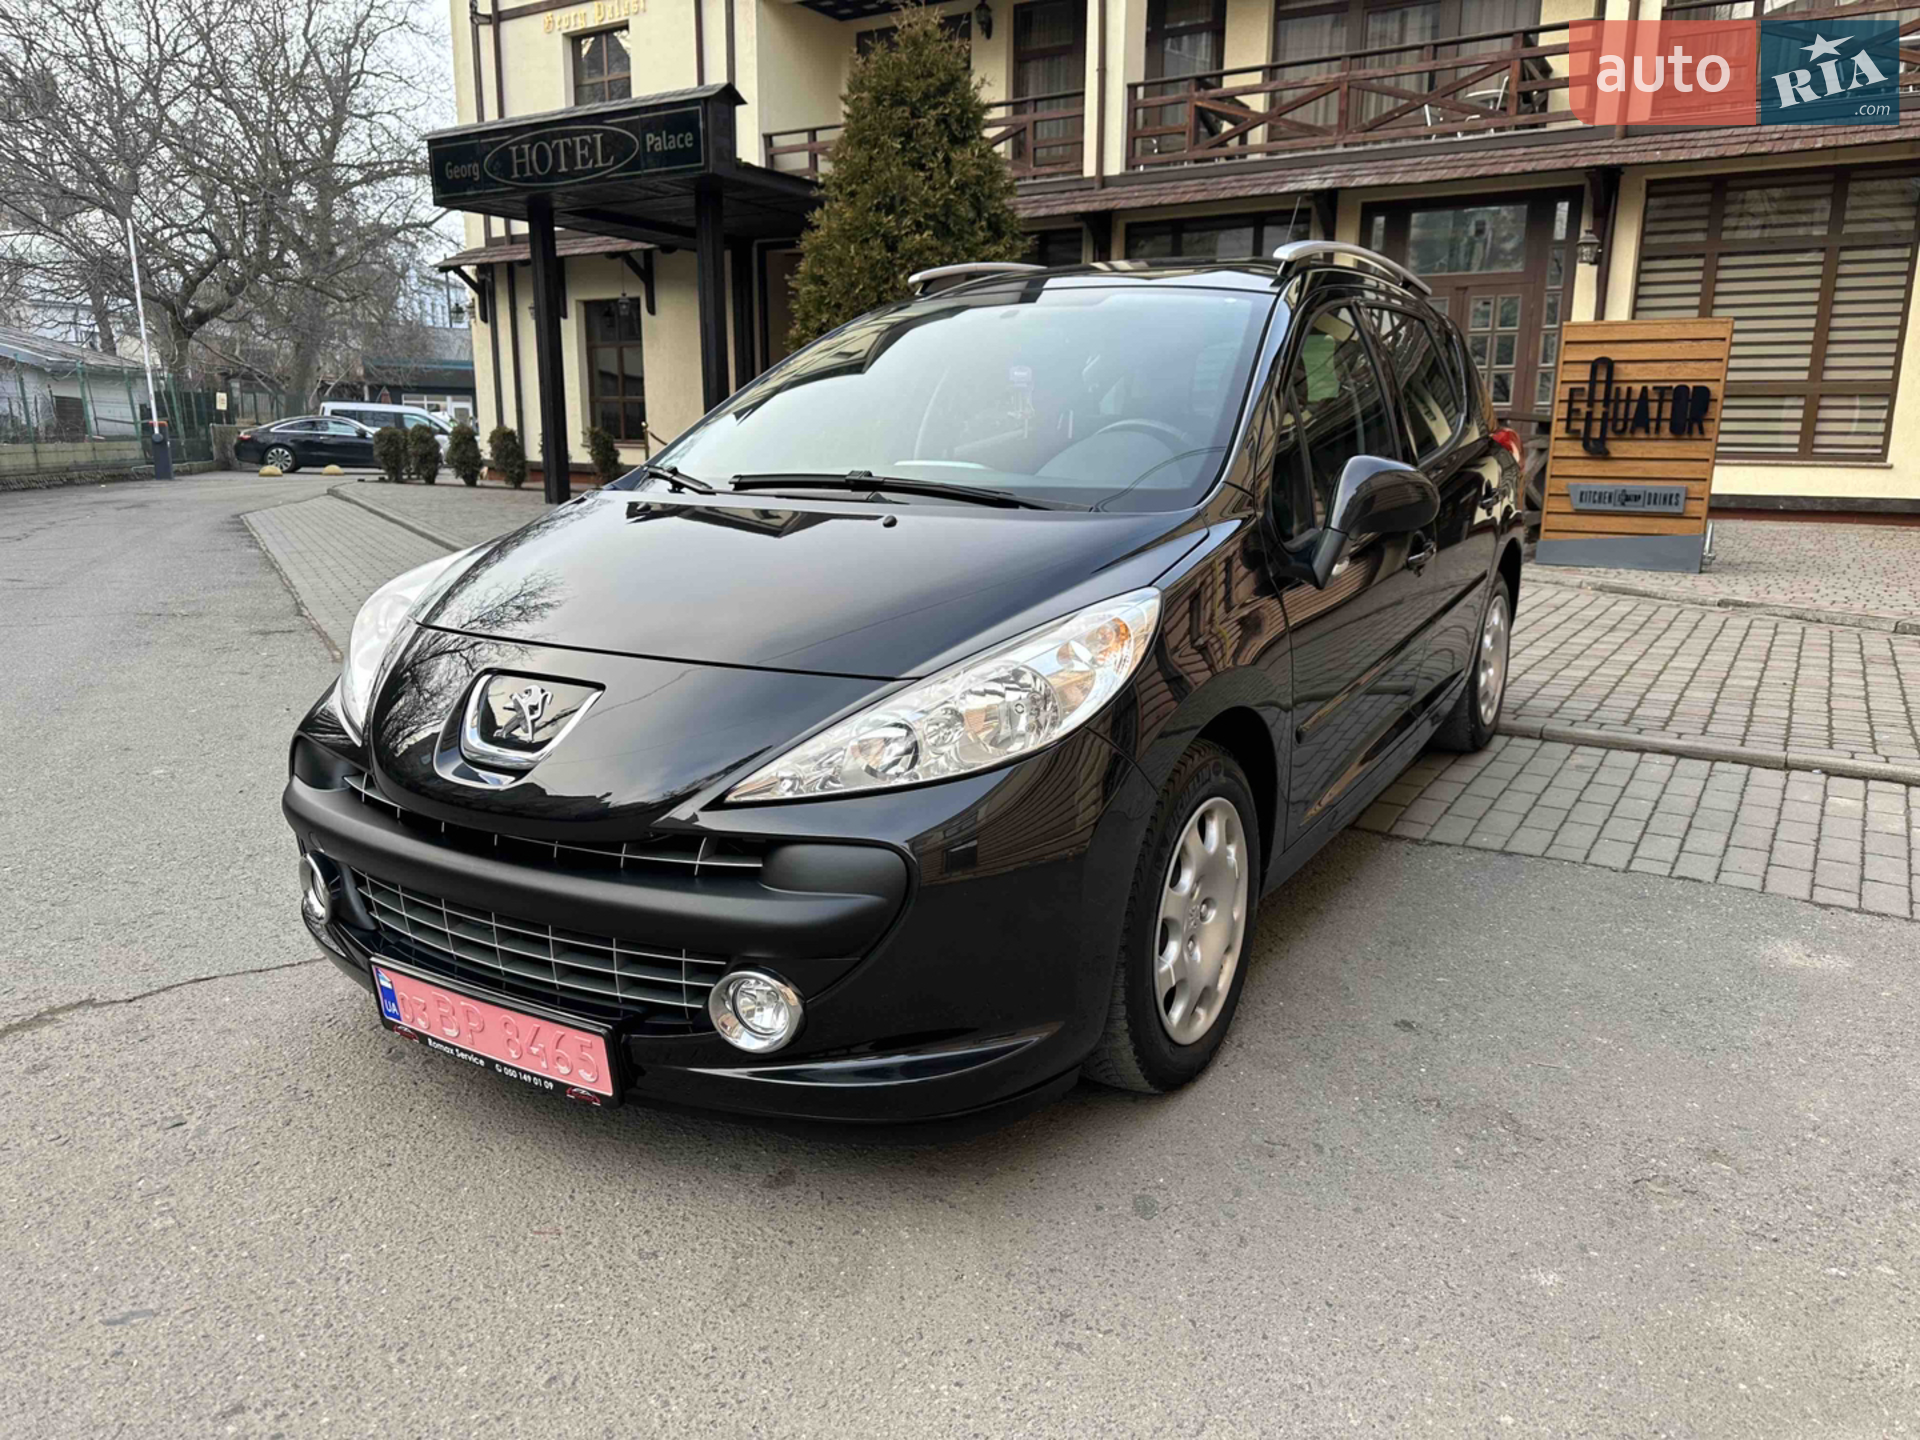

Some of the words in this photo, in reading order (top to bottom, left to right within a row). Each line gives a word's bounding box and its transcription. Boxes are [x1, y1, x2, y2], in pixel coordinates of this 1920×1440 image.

[645, 130, 694, 153] Palace
[509, 133, 614, 178] HOTEL
[445, 160, 480, 181] Georg
[1565, 357, 1711, 456] EQUATOR
[1579, 490, 1613, 505] KITCHEN
[1647, 491, 1680, 506] DRINKS
[384, 1000, 399, 1016] UA
[431, 991, 485, 1046] BP
[499, 1014, 599, 1083] 8465
[455, 1048, 485, 1067] Service
[503, 1066, 518, 1079] 050
[519, 1072, 531, 1083] 149
[533, 1077, 542, 1087] 01
[544, 1080, 554, 1090] 09
